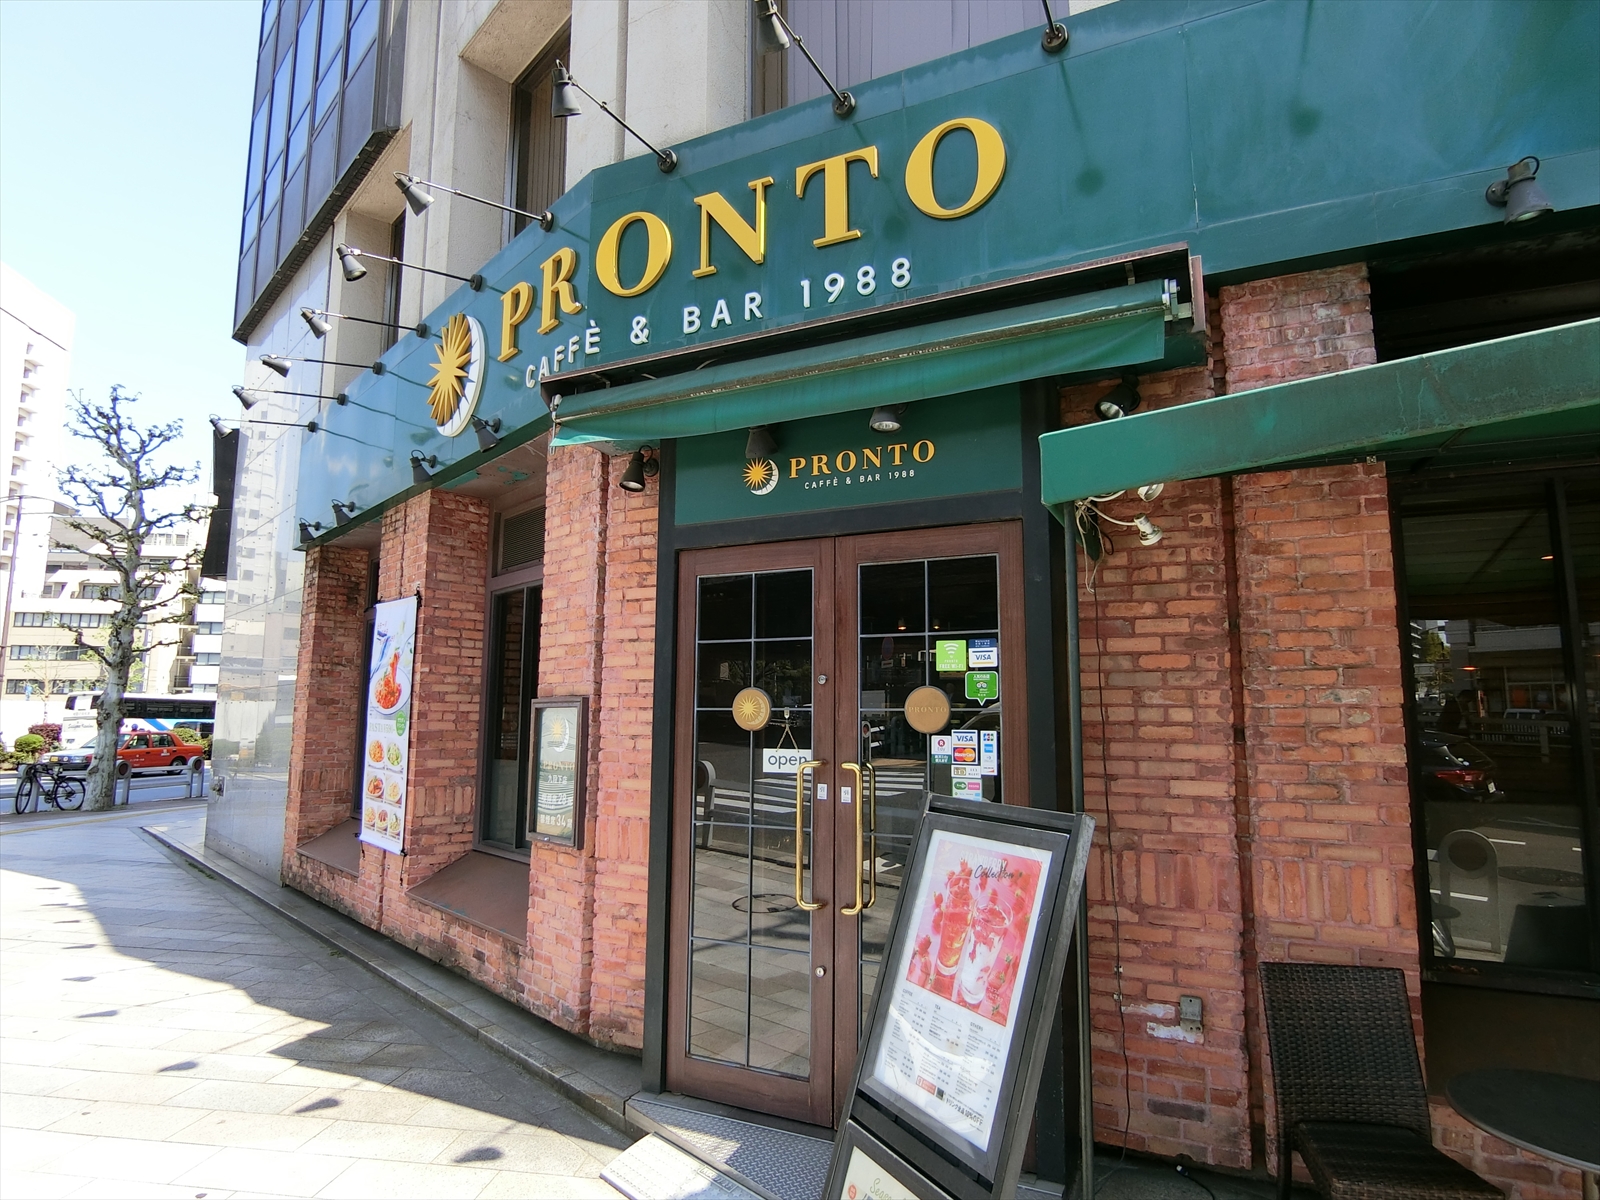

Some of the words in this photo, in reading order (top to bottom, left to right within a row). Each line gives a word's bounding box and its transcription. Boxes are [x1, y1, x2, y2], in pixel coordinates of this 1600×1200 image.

[498, 117, 1007, 363] PRONTO
[525, 319, 602, 388] CAFFÈ
[630, 314, 650, 345] &
[683, 291, 763, 335] BAR
[800, 257, 912, 308] 1988
[788, 439, 935, 479] PRONTO
[804, 476, 838, 490] CAFFÈ
[845, 476, 852, 485] &
[859, 473, 881, 483] BAR
[888, 469, 915, 480] 1988
[908, 705, 948, 714] PRONTO
[768, 755, 807, 769] open
[974, 864, 1014, 881] Collection
